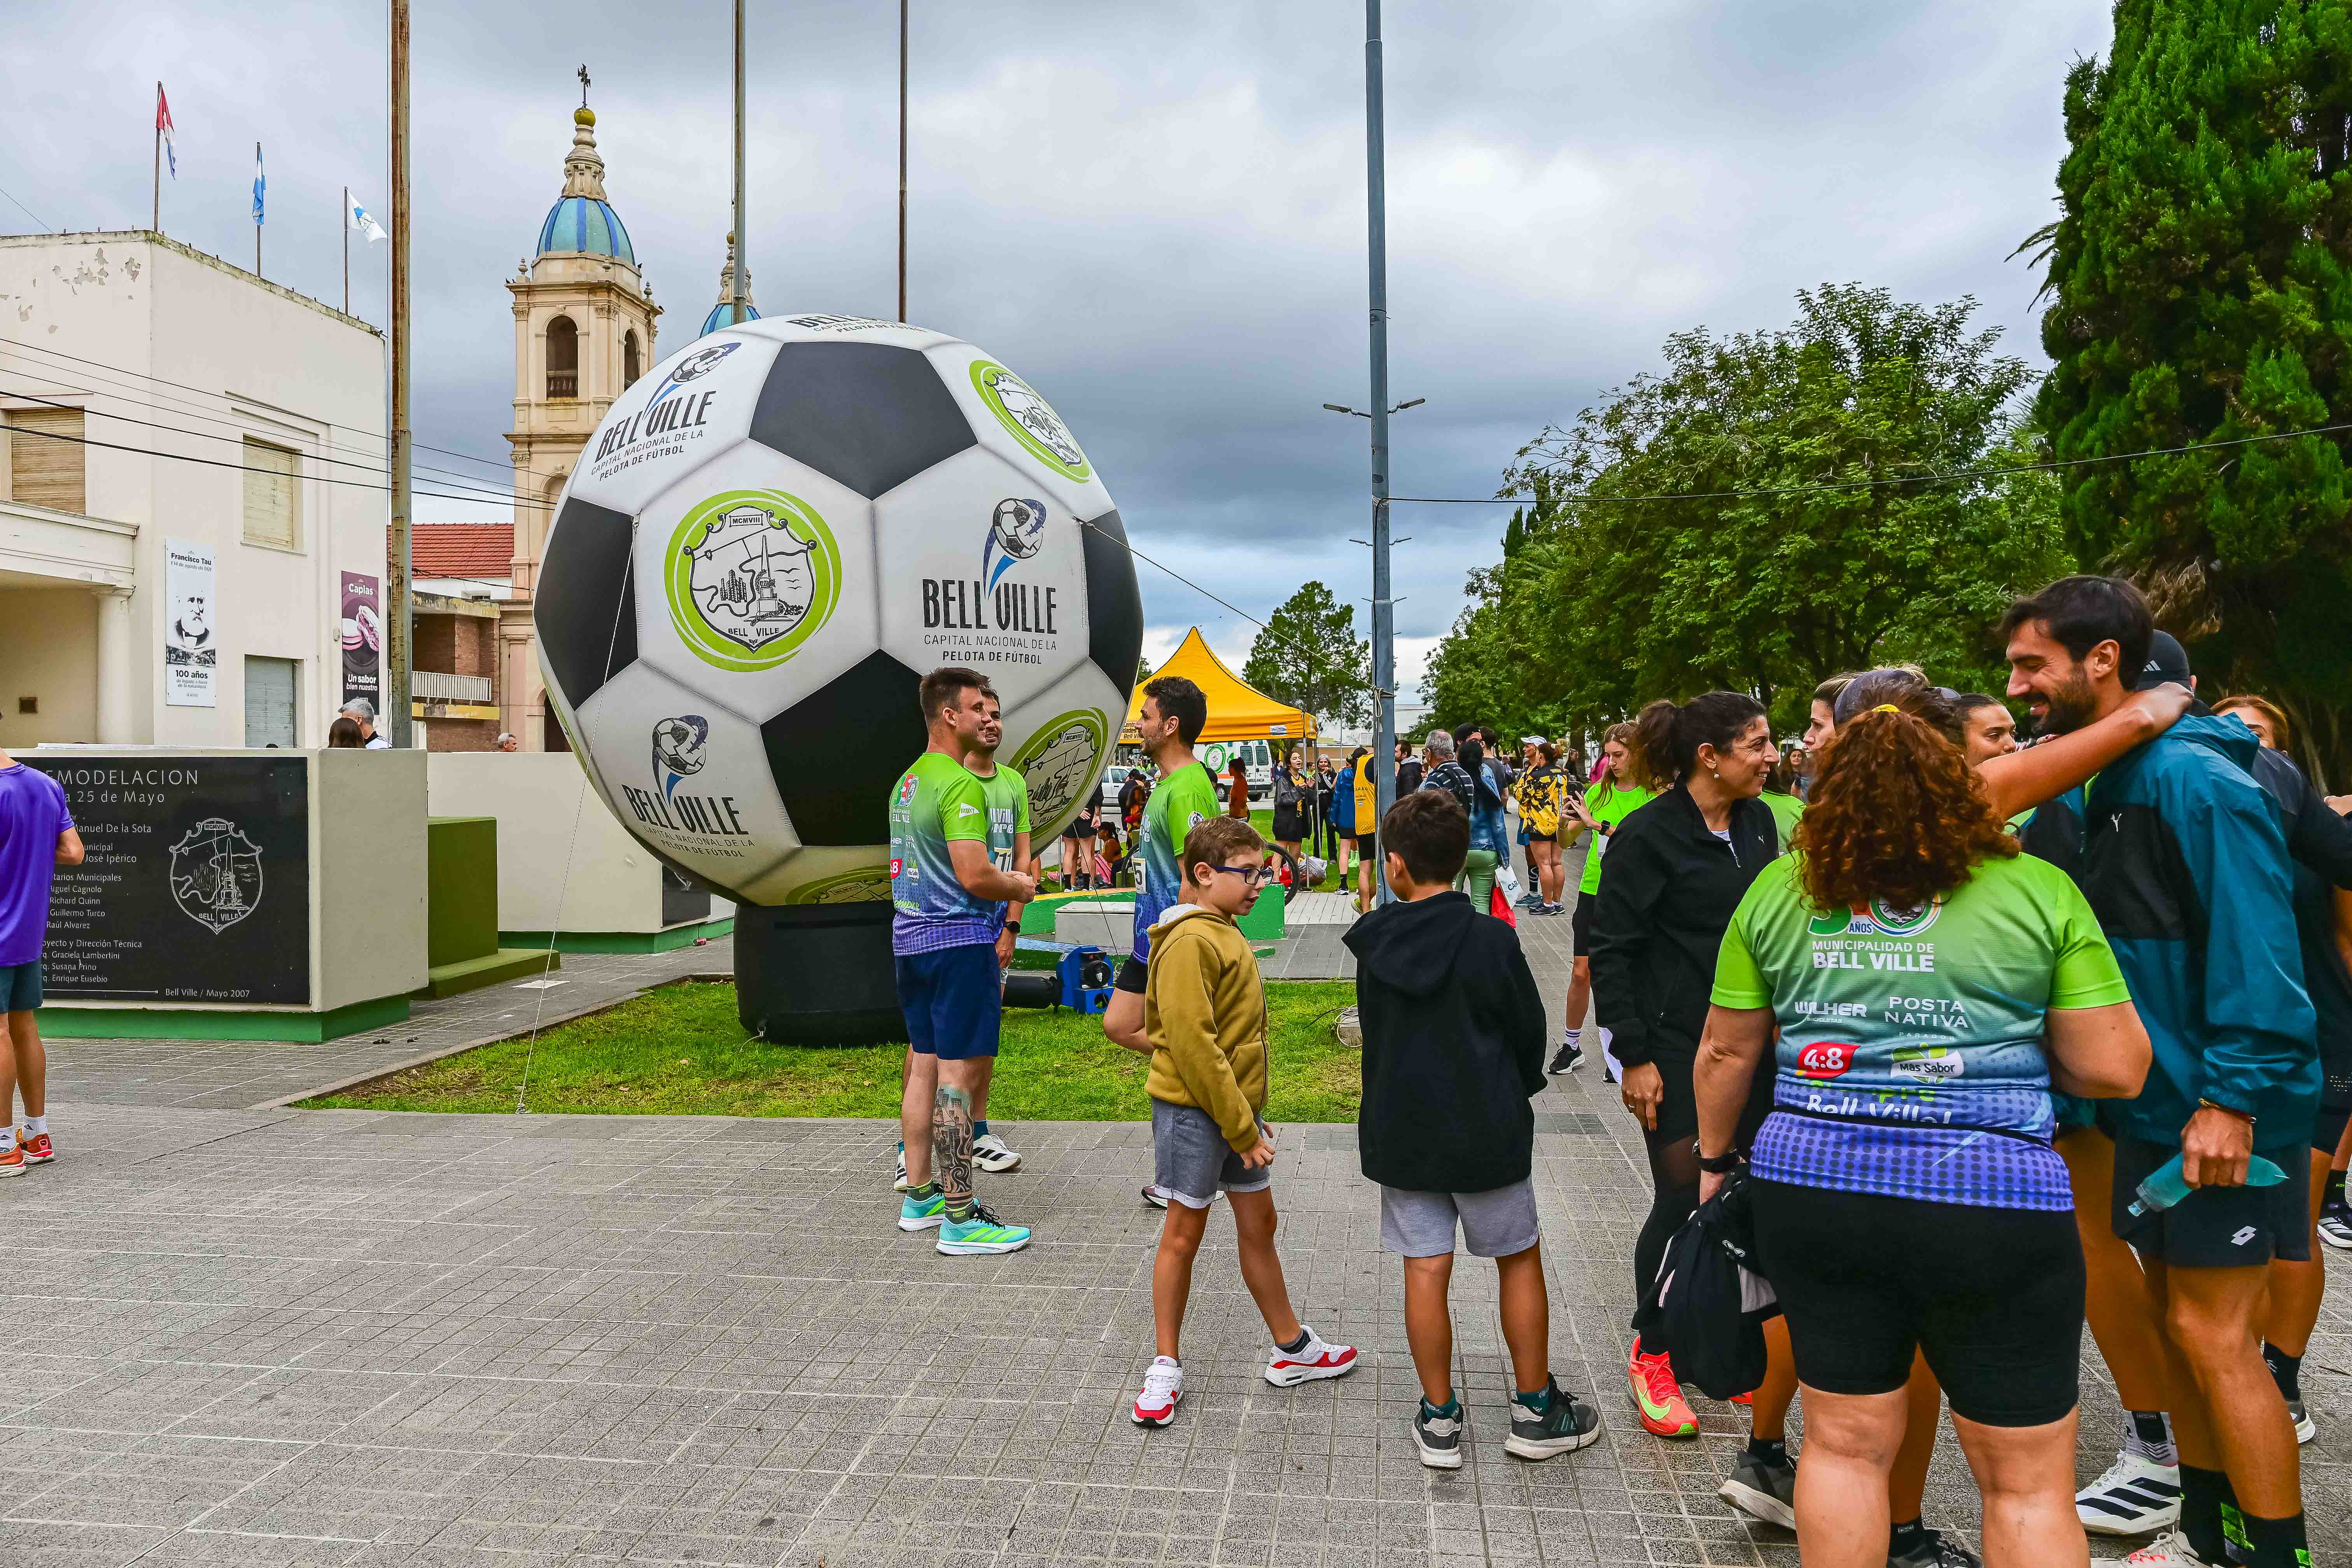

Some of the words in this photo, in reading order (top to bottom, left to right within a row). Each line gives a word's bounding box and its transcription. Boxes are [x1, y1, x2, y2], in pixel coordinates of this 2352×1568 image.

[595, 411, 643, 463] BELL
[591, 453, 622, 476] CAPITAL
[624, 436, 671, 457] NACIONAL
[674, 432, 688, 442] DE
[691, 430, 704, 439] LA
[599, 460, 629, 482] PELOTA
[632, 454, 644, 466] DE
[646, 444, 684, 462] FÚTBOL
[171, 552, 200, 563] Francisco
[921, 579, 988, 629] BELL
[728, 628, 748, 637] BELL
[756, 628, 780, 637] VILLE
[924, 634, 972, 646] CAPITAL
[976, 636, 1028, 648] NACIONAL
[1031, 639, 1043, 649] DE
[1046, 640, 1057, 651] LA
[942, 651, 985, 661] PELOTA
[989, 652, 1002, 662] DE
[1005, 650, 1042, 664] FÚTBOL
[191, 670, 208, 679] años
[348, 674, 357, 682] Un
[358, 674, 376, 684] sabor
[77, 791, 94, 803] 25
[101, 790, 117, 803] de
[124, 791, 165, 806] Mayo
[621, 784, 680, 831] BELL
[107, 824, 118, 833] De
[122, 823, 129, 833] la
[132, 824, 152, 833] Sota
[644, 825, 674, 840] CAPITAL
[677, 833, 723, 847] NACIONAL
[725, 838, 740, 847] DE
[742, 839, 756, 847] LA
[84, 843, 113, 852] unicipal
[661, 839, 690, 853] PELOTA
[691, 846, 705, 855] DE
[707, 845, 746, 858] FÚTBOL
[84, 853, 103, 863] José
[107, 854, 137, 865] Ipérico
[77, 873, 122, 884] Municipales
[72, 886, 102, 894] Cagnolo
[78, 897, 100, 905] Quinn
[199, 912, 214, 921] BELL
[220, 912, 238, 921] VILLE
[1849, 922, 1872, 933] AÑOS
[42, 940, 67, 948] oyecto
[69, 940, 74, 949] y
[77, 940, 111, 948] Dirección
[113, 940, 142, 948] Técnica
[1812, 940, 1913, 953] MUNICIPALIDAD
[1916, 942, 1936, 953] DE
[1813, 951, 1864, 970] BELL
[1869, 952, 1935, 973] VILLE
[52, 975, 79, 984] Enrique
[181, 988, 198, 997] Ville
[206, 990, 228, 999] Mayo
[1888, 996, 1964, 1013] POSTA
[1885, 1011, 1969, 1028] NATIVA
[1899, 1031, 1956, 1041] PARADOR
[1804, 1047, 1844, 1070] 4:8
[1924, 1062, 1956, 1073] Sabor
